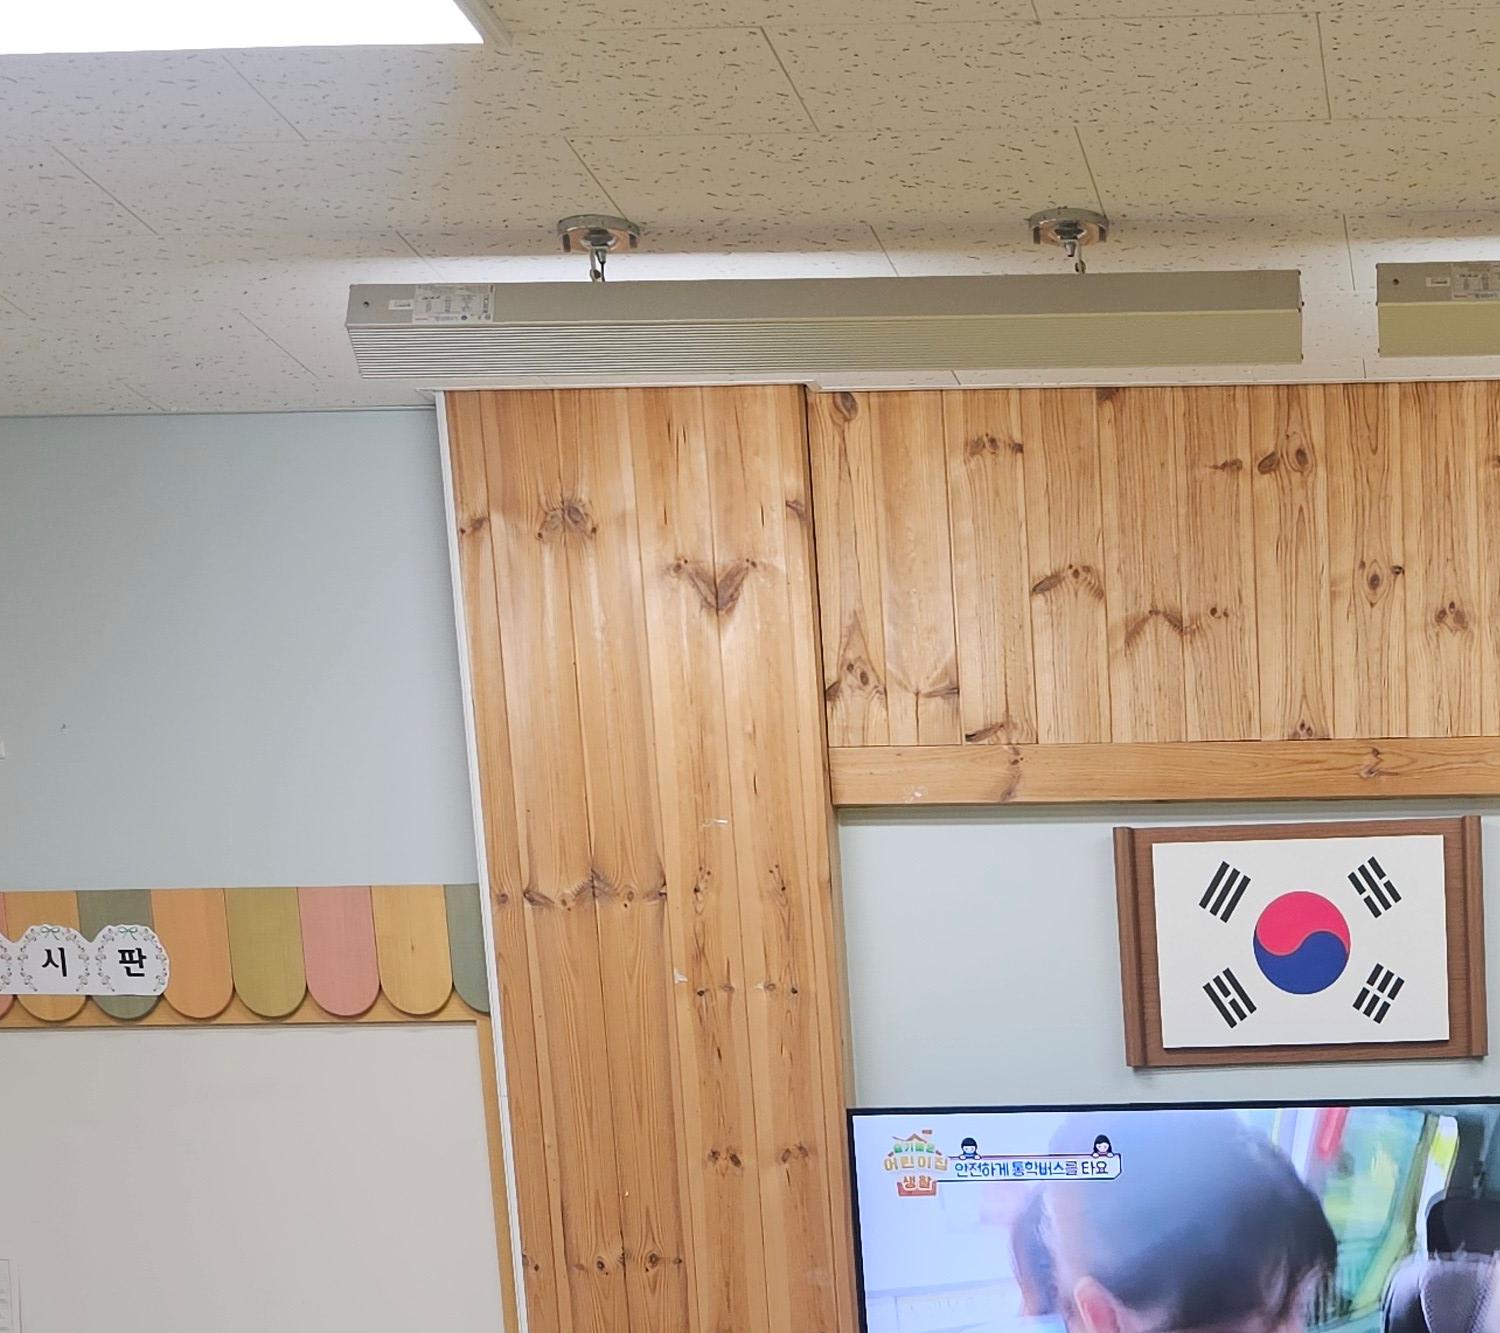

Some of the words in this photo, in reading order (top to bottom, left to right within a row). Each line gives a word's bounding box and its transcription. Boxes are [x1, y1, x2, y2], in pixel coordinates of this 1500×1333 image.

[955, 1162, 1010, 1177] 안전하게
[1012, 1161, 1078, 1177] 통학버스를
[1081, 1160, 1109, 1176] 타요
